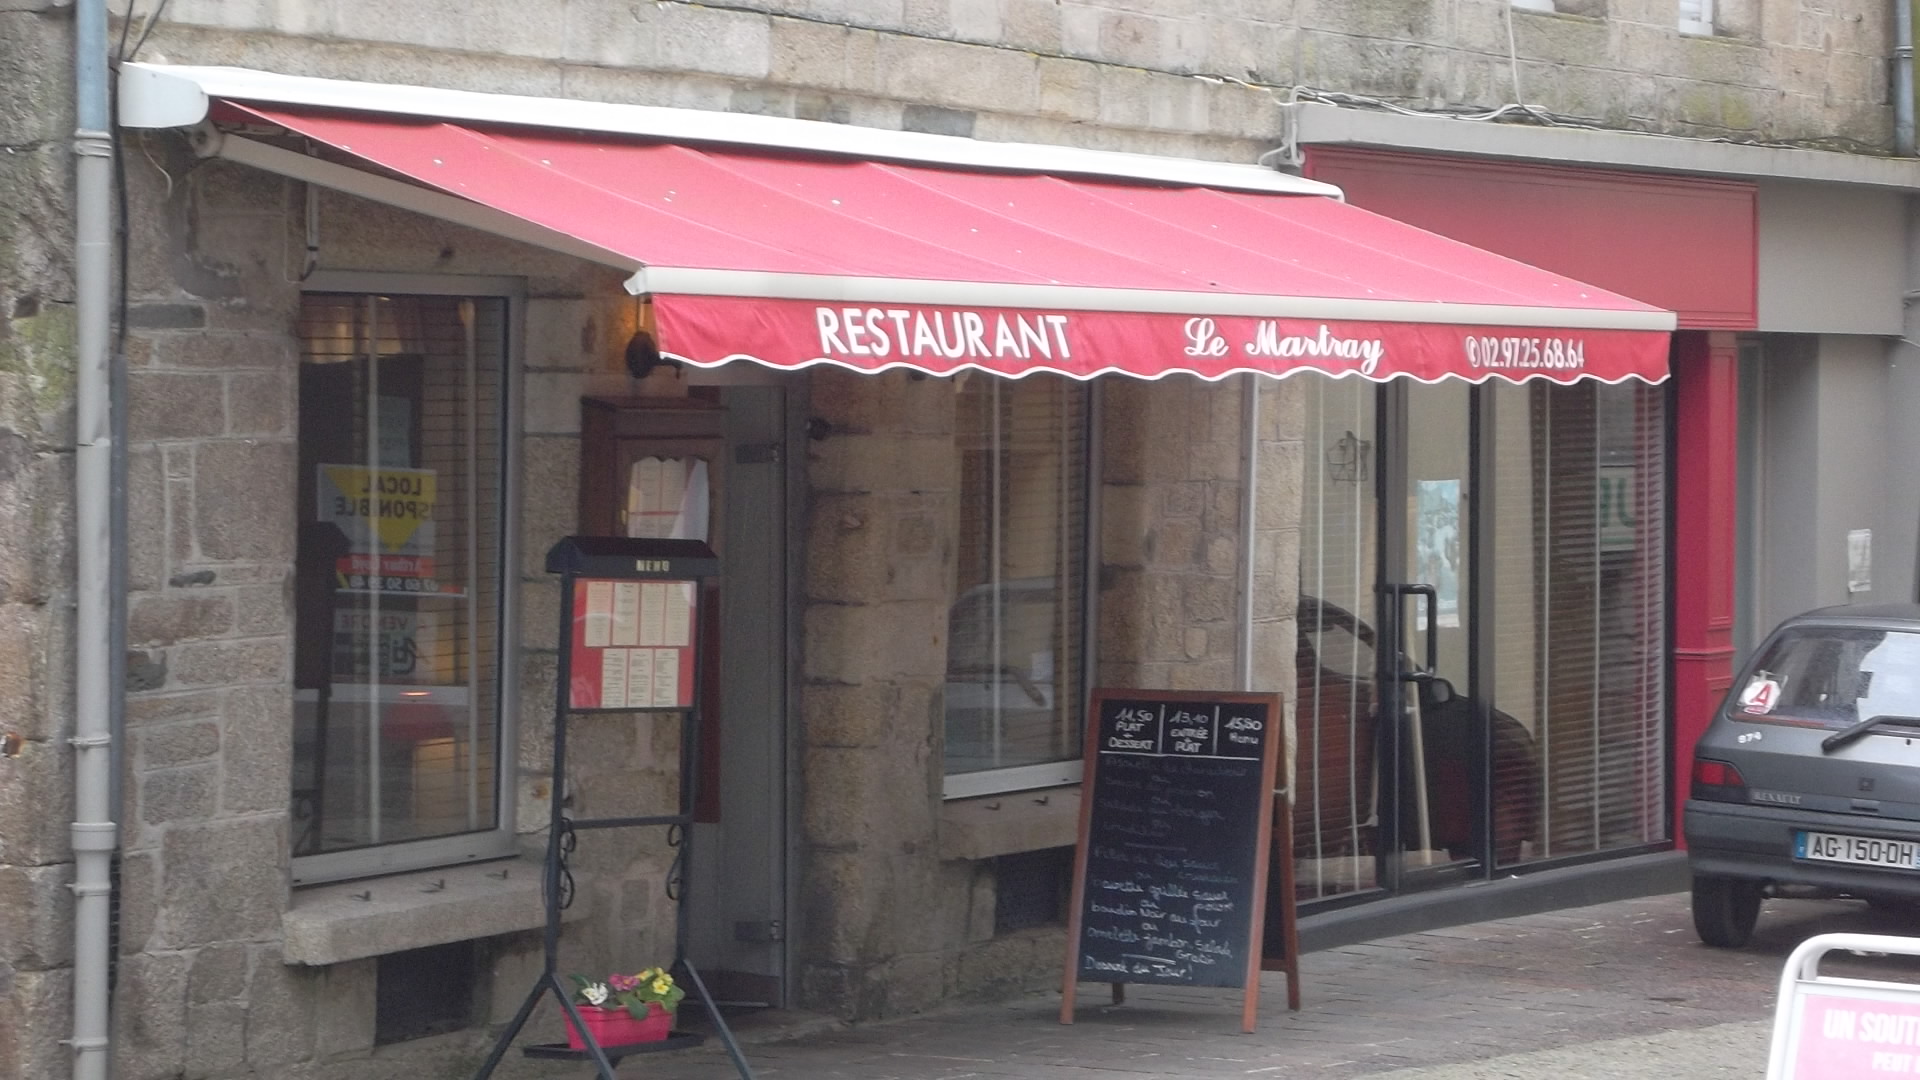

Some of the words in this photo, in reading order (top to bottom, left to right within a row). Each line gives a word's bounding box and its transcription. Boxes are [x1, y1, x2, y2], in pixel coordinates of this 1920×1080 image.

[816, 307, 1071, 359] RESTAURANT
[1184, 317, 1229, 357] Le
[1246, 319, 1385, 375] Martray
[1824, 1008, 1857, 1040] UN
